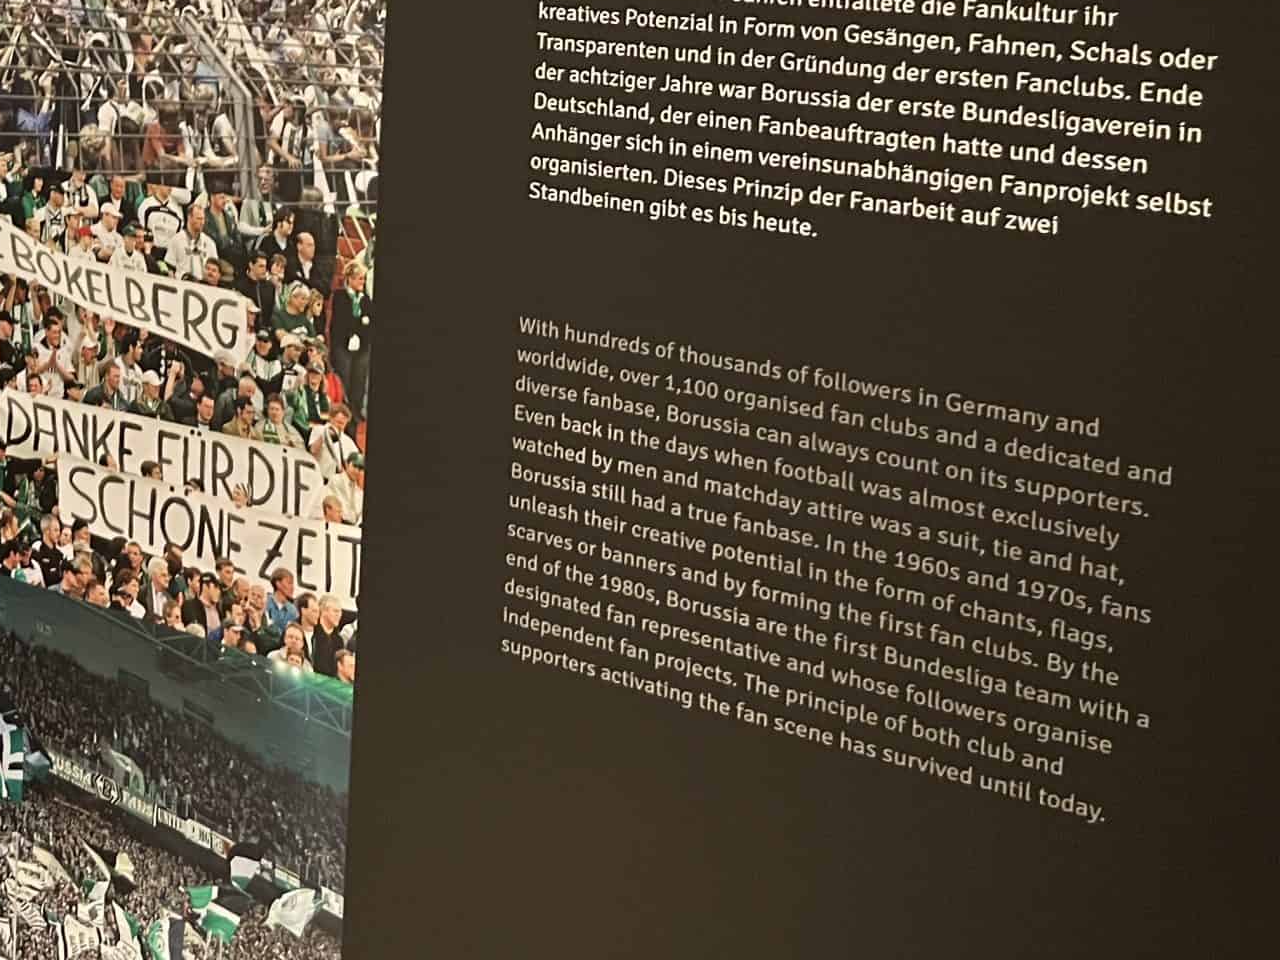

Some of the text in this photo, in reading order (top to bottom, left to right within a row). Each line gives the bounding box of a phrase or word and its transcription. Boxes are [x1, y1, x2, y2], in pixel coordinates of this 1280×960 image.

[536, 31, 1204, 107] Transparenten und in der Gründung der ersten Fanclubs. Ende
[1083, 4, 1120, 28] ihr
[533, 91, 1148, 175] Deutschland, der einen Fanbeauftragten hatte und dessen
[514, 403, 1120, 552] Even back in the days when football was almost exclusively
[516, 348, 1173, 487] worldwide, over 1,100 organised fan clubs and a dedicated and
[69, 464, 363, 599] SCHÖNE ZEIT
[511, 461, 1152, 624] Borussia still had a true fanbase. In the 1960s and 1970s, fans
[504, 577, 1113, 755] designated fan representative and whose followers organise
[506, 523, 1120, 687] scarves or banners and by forming the first fan clubs. By the
[500, 638, 1106, 824] supporters activating the fan scene has survived until today.
